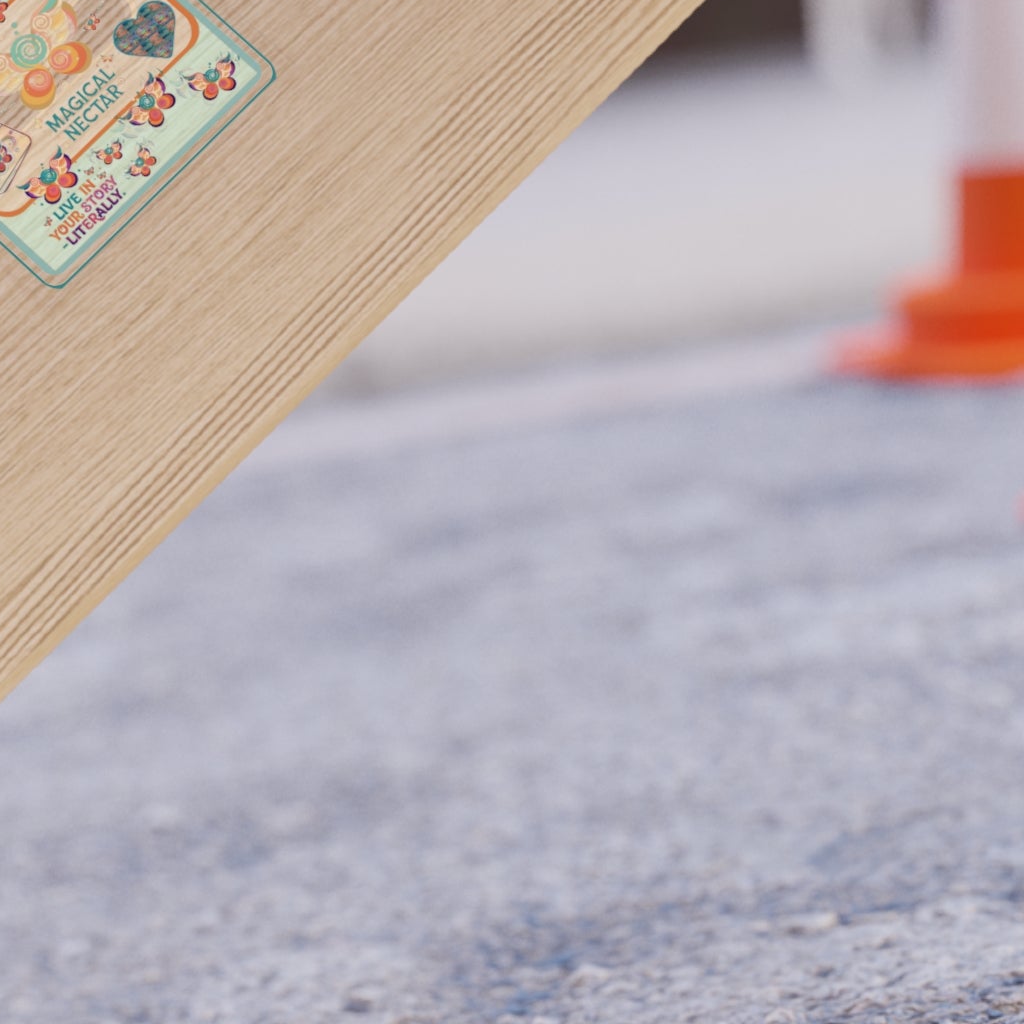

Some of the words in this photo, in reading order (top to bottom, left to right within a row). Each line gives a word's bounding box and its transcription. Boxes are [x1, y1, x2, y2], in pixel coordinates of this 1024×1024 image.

[45, 68, 115, 133] MAGICAL
[63, 84, 124, 141] NECTAR
[49, 210, 85, 241] YOUR
[81, 175, 117, 213] STORY
[53, 192, 82, 221] LIVE
[78, 179, 96, 195] IN
